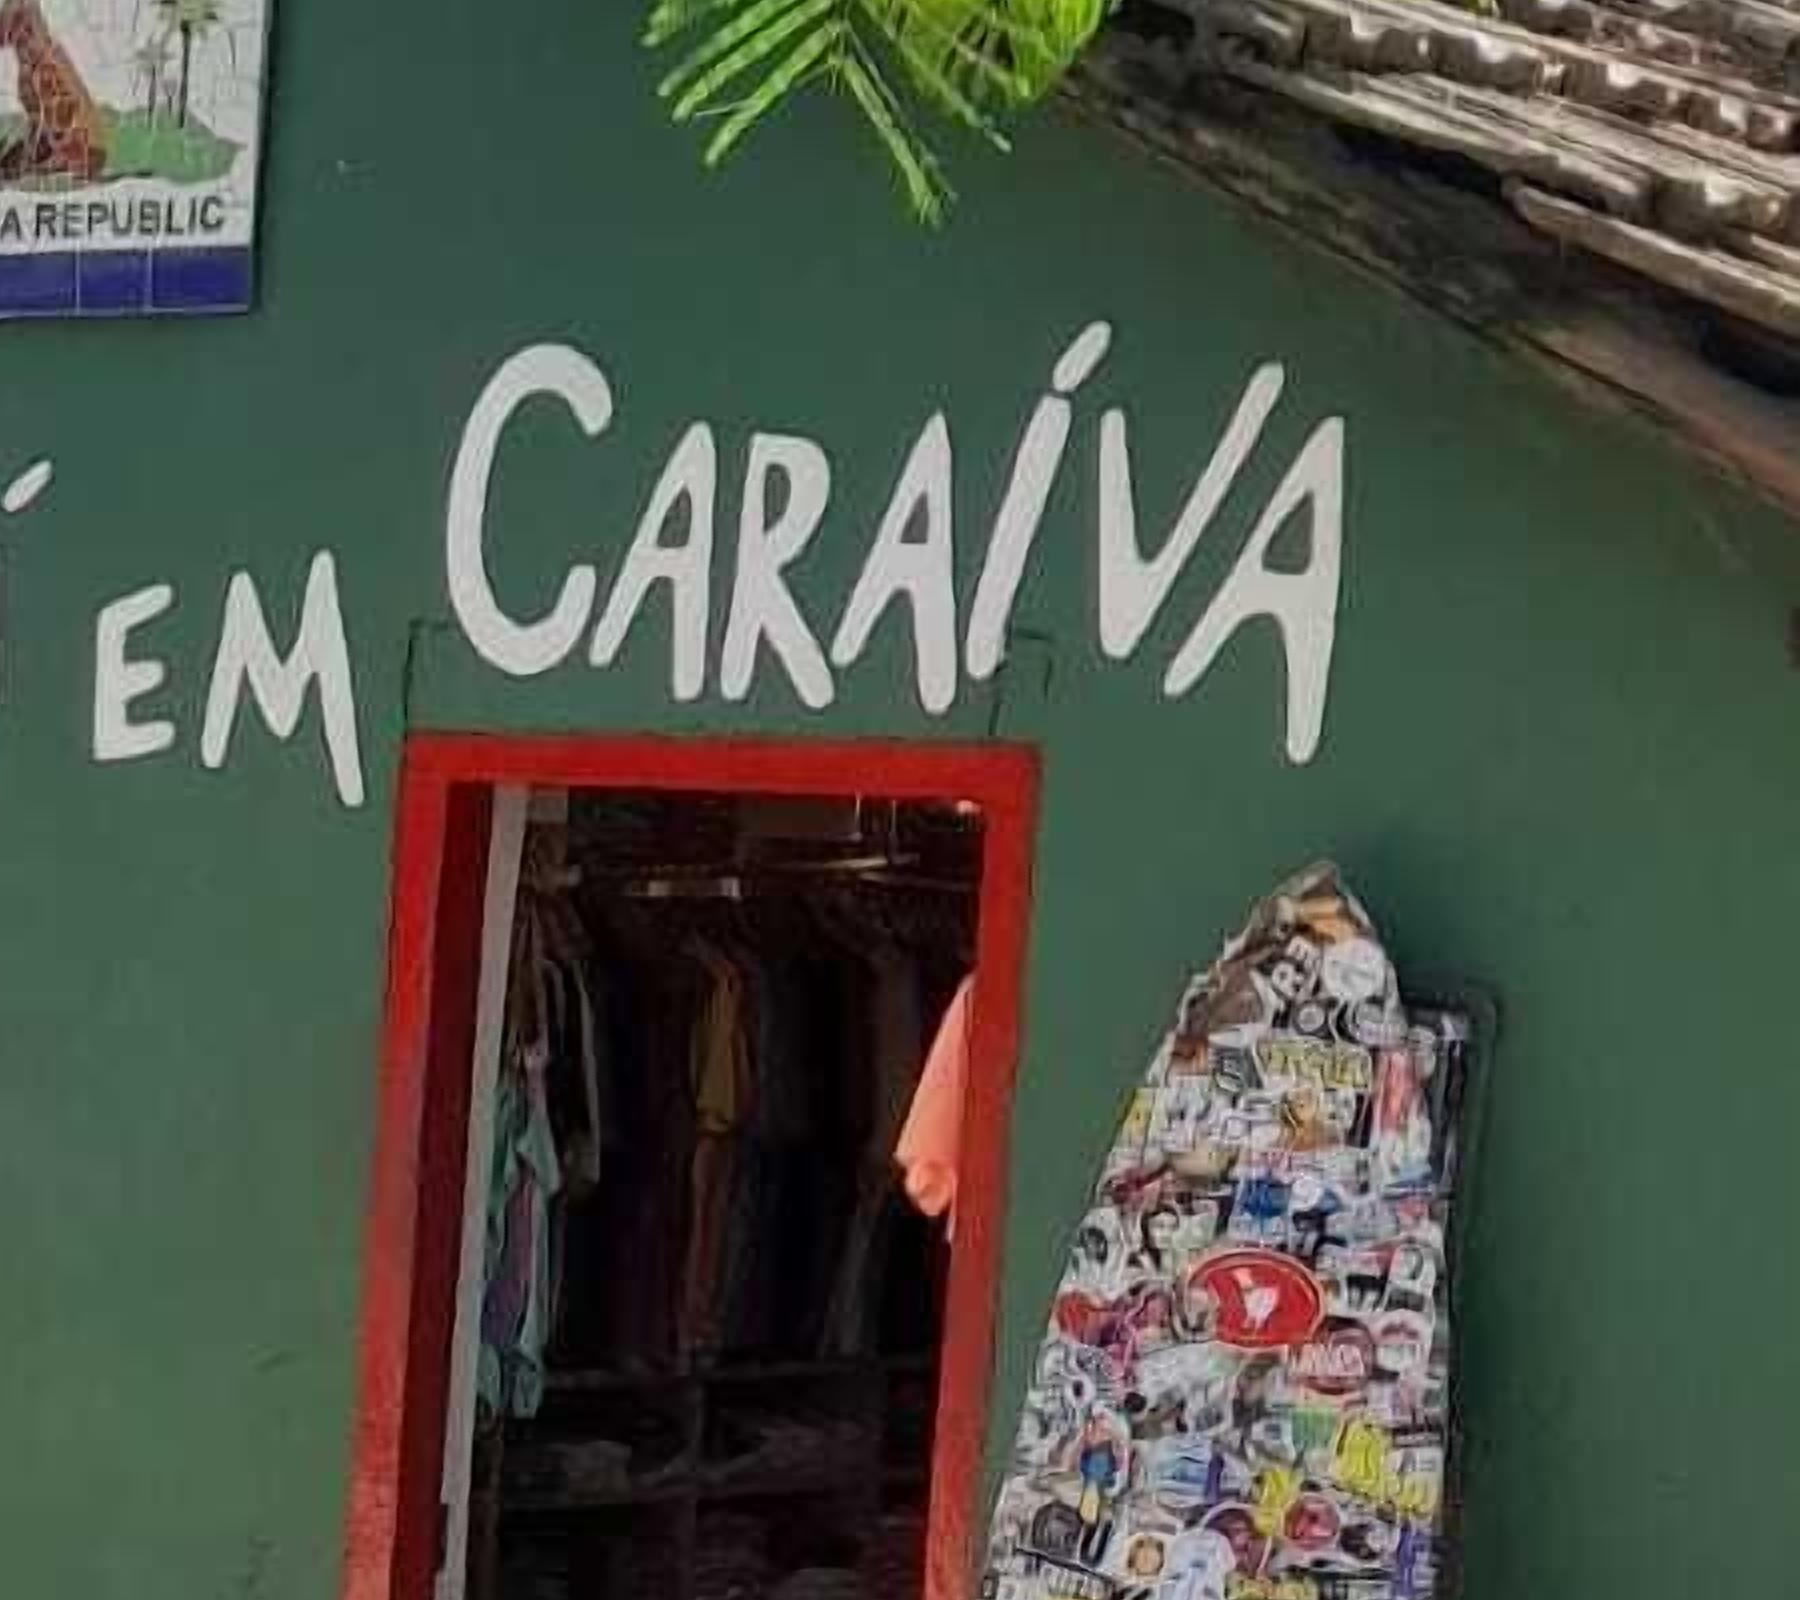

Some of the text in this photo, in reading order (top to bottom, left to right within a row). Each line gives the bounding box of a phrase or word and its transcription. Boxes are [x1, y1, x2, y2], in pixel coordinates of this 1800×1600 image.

[36, 196, 225, 239] REPUBLIC
[91, 549, 365, 808] EM
[445, 320, 1345, 765] CARAÍVA
